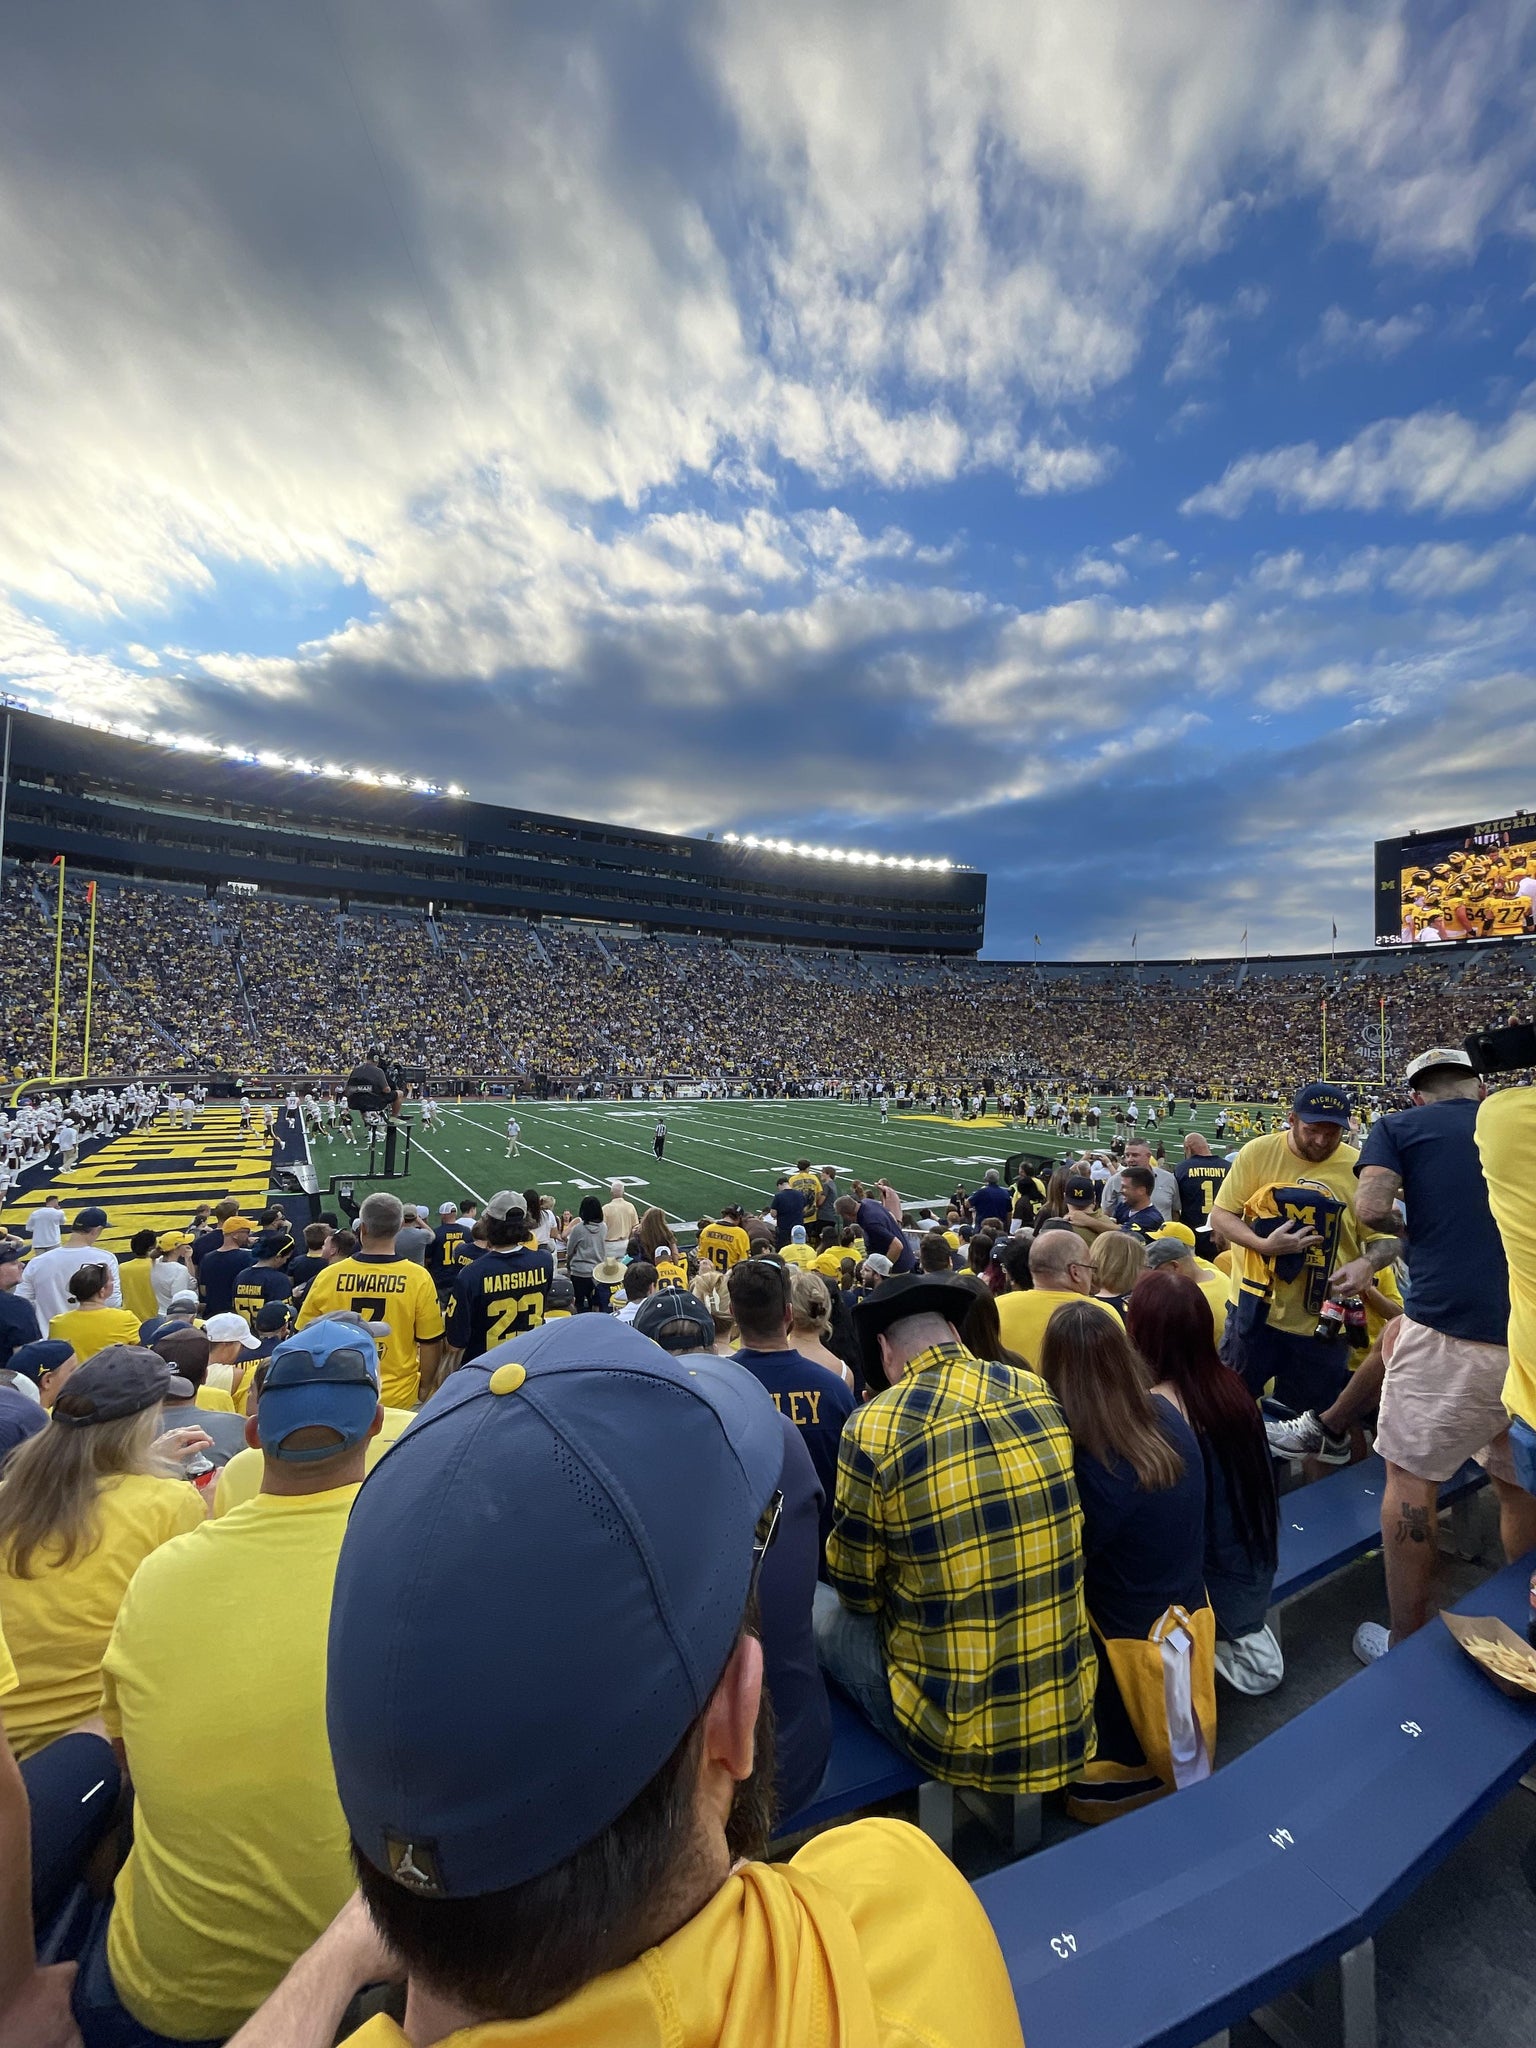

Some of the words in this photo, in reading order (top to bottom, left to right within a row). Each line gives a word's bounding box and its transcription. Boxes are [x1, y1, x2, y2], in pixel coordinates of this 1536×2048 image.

[1497, 907, 1526, 924] 77
[1354, 1046, 1400, 1058] Allstate
[1310, 1096, 1345, 1110] MICHIGAN
[1188, 1167, 1225, 1178] ANTHONY
[567, 1175, 650, 1190] 10
[1074, 1189, 1084, 1197] M
[1284, 1202, 1316, 1225] M
[708, 1246, 728, 1274] 19
[336, 1273, 407, 1293] EDWARDS
[484, 1267, 547, 1294] MARSHALL
[237, 1284, 262, 1296] GRAHAM
[486, 1292, 545, 1352] 23
[1400, 1720, 1423, 1737] 45
[1268, 1827, 1295, 1850] 44
[1050, 1932, 1077, 1958] 43
